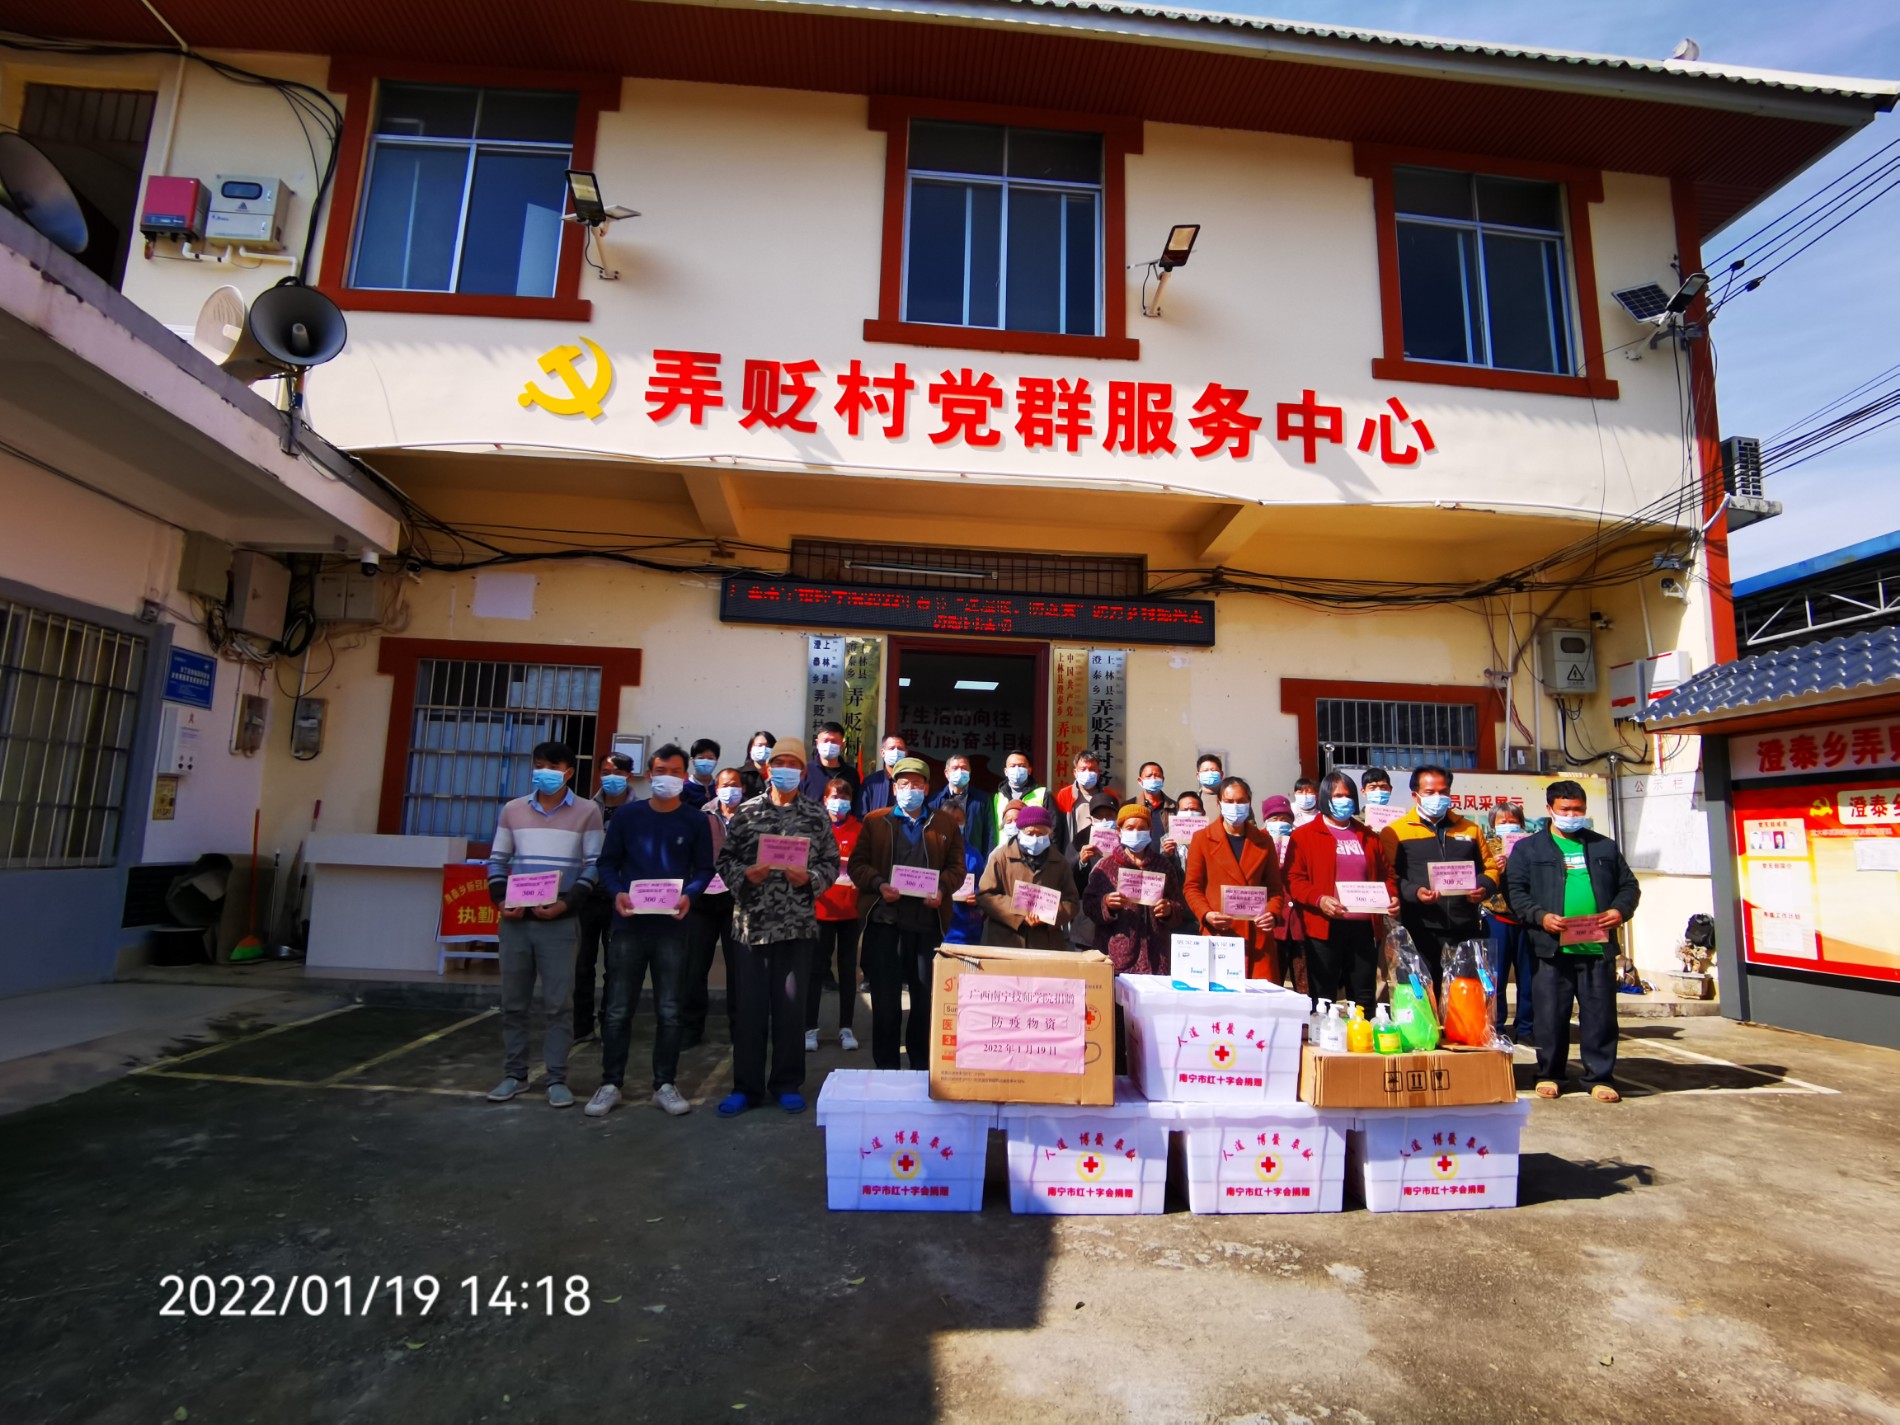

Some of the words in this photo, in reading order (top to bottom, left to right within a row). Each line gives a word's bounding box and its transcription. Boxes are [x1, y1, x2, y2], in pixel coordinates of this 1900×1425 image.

[645, 349, 1436, 465] 弄贬村党群服务中心
[969, 988, 1075, 1006] 广西南宁技师学院捐赠
[991, 1014, 1056, 1031] 防疫物资
[1179, 1073, 1263, 1087] 南宁市红十字会捐赠
[862, 1185, 949, 1196] 南宁市红十字会捐赠
[1047, 1187, 1134, 1198] 南宁市红十字会捐赠
[1226, 1187, 1311, 1197] 南宁市红十字会捐赠
[1403, 1185, 1486, 1196] 南宁市红十字会捐赠
